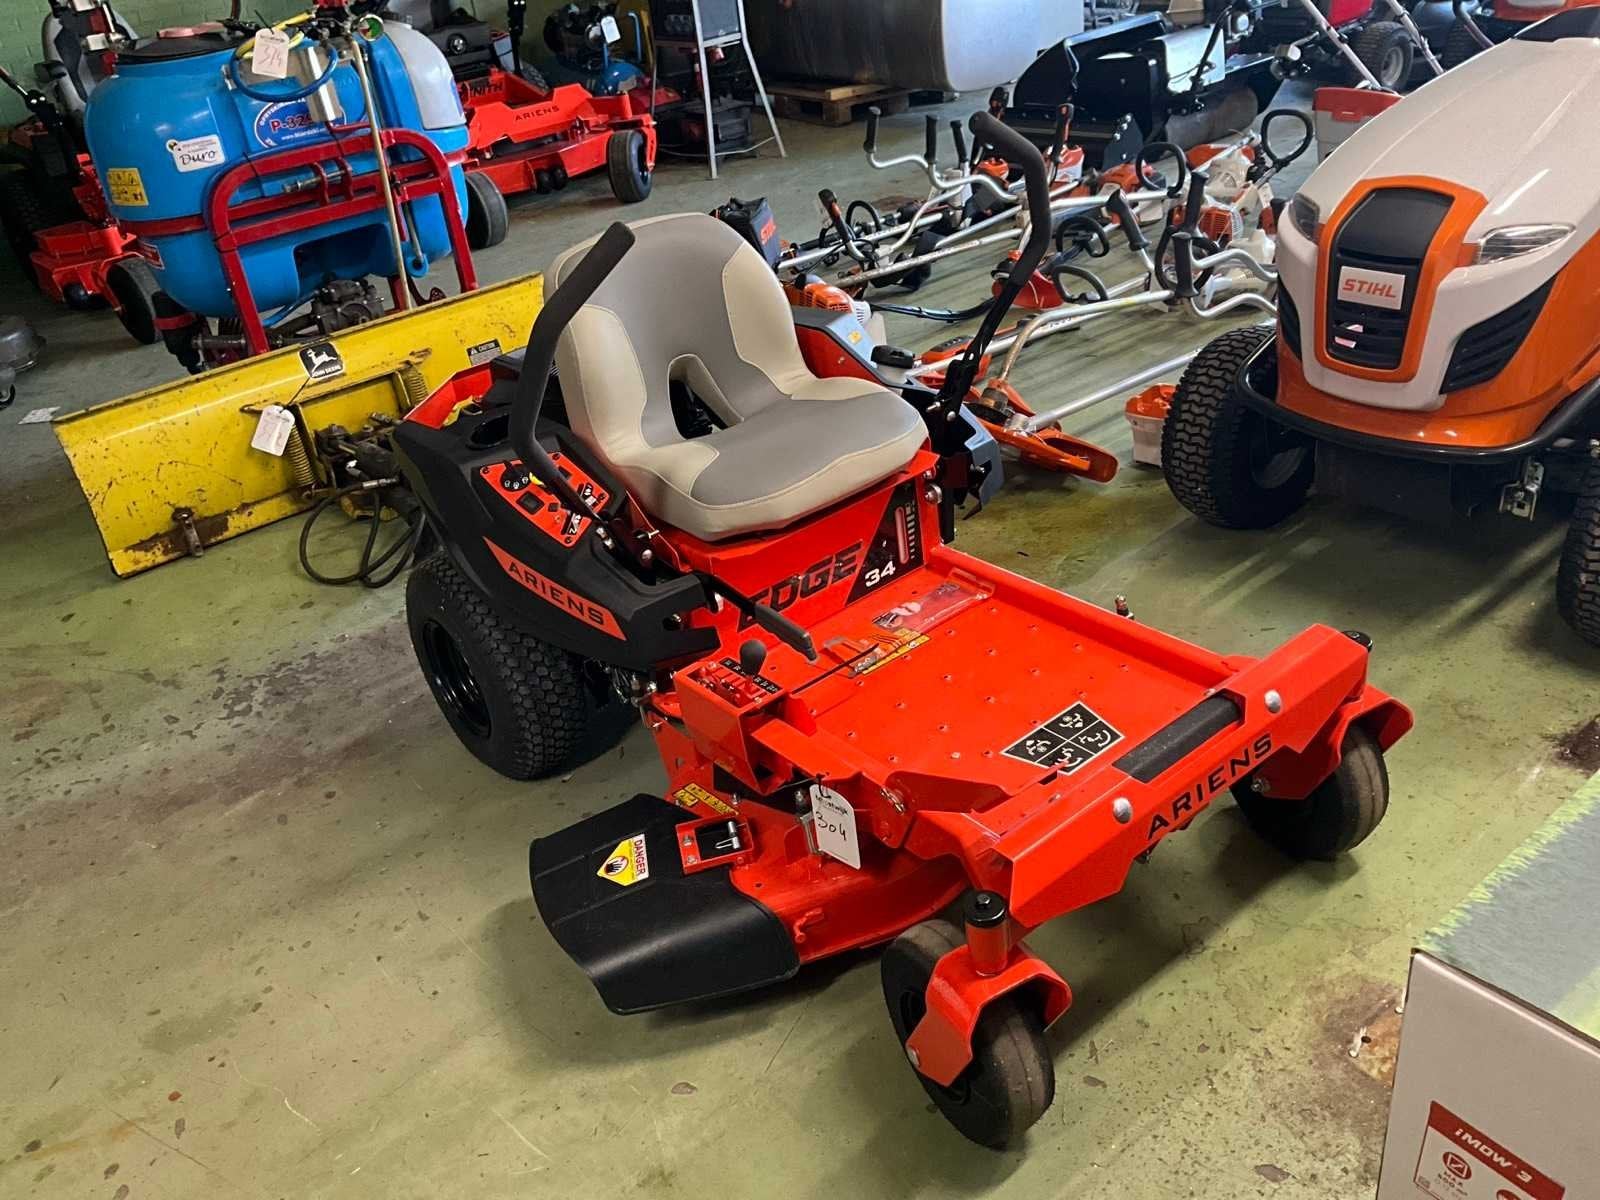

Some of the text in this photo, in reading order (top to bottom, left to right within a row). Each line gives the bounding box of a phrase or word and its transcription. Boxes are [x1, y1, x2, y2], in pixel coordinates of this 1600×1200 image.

[515, 105, 560, 121] ARIENS
[1342, 278, 1397, 298] STIHL
[864, 560, 896, 587] 34
[508, 561, 604, 625] ARIENS
[1147, 732, 1272, 840] ARIENS
[815, 810, 847, 841] 304
[634, 839, 646, 876] DANGER
